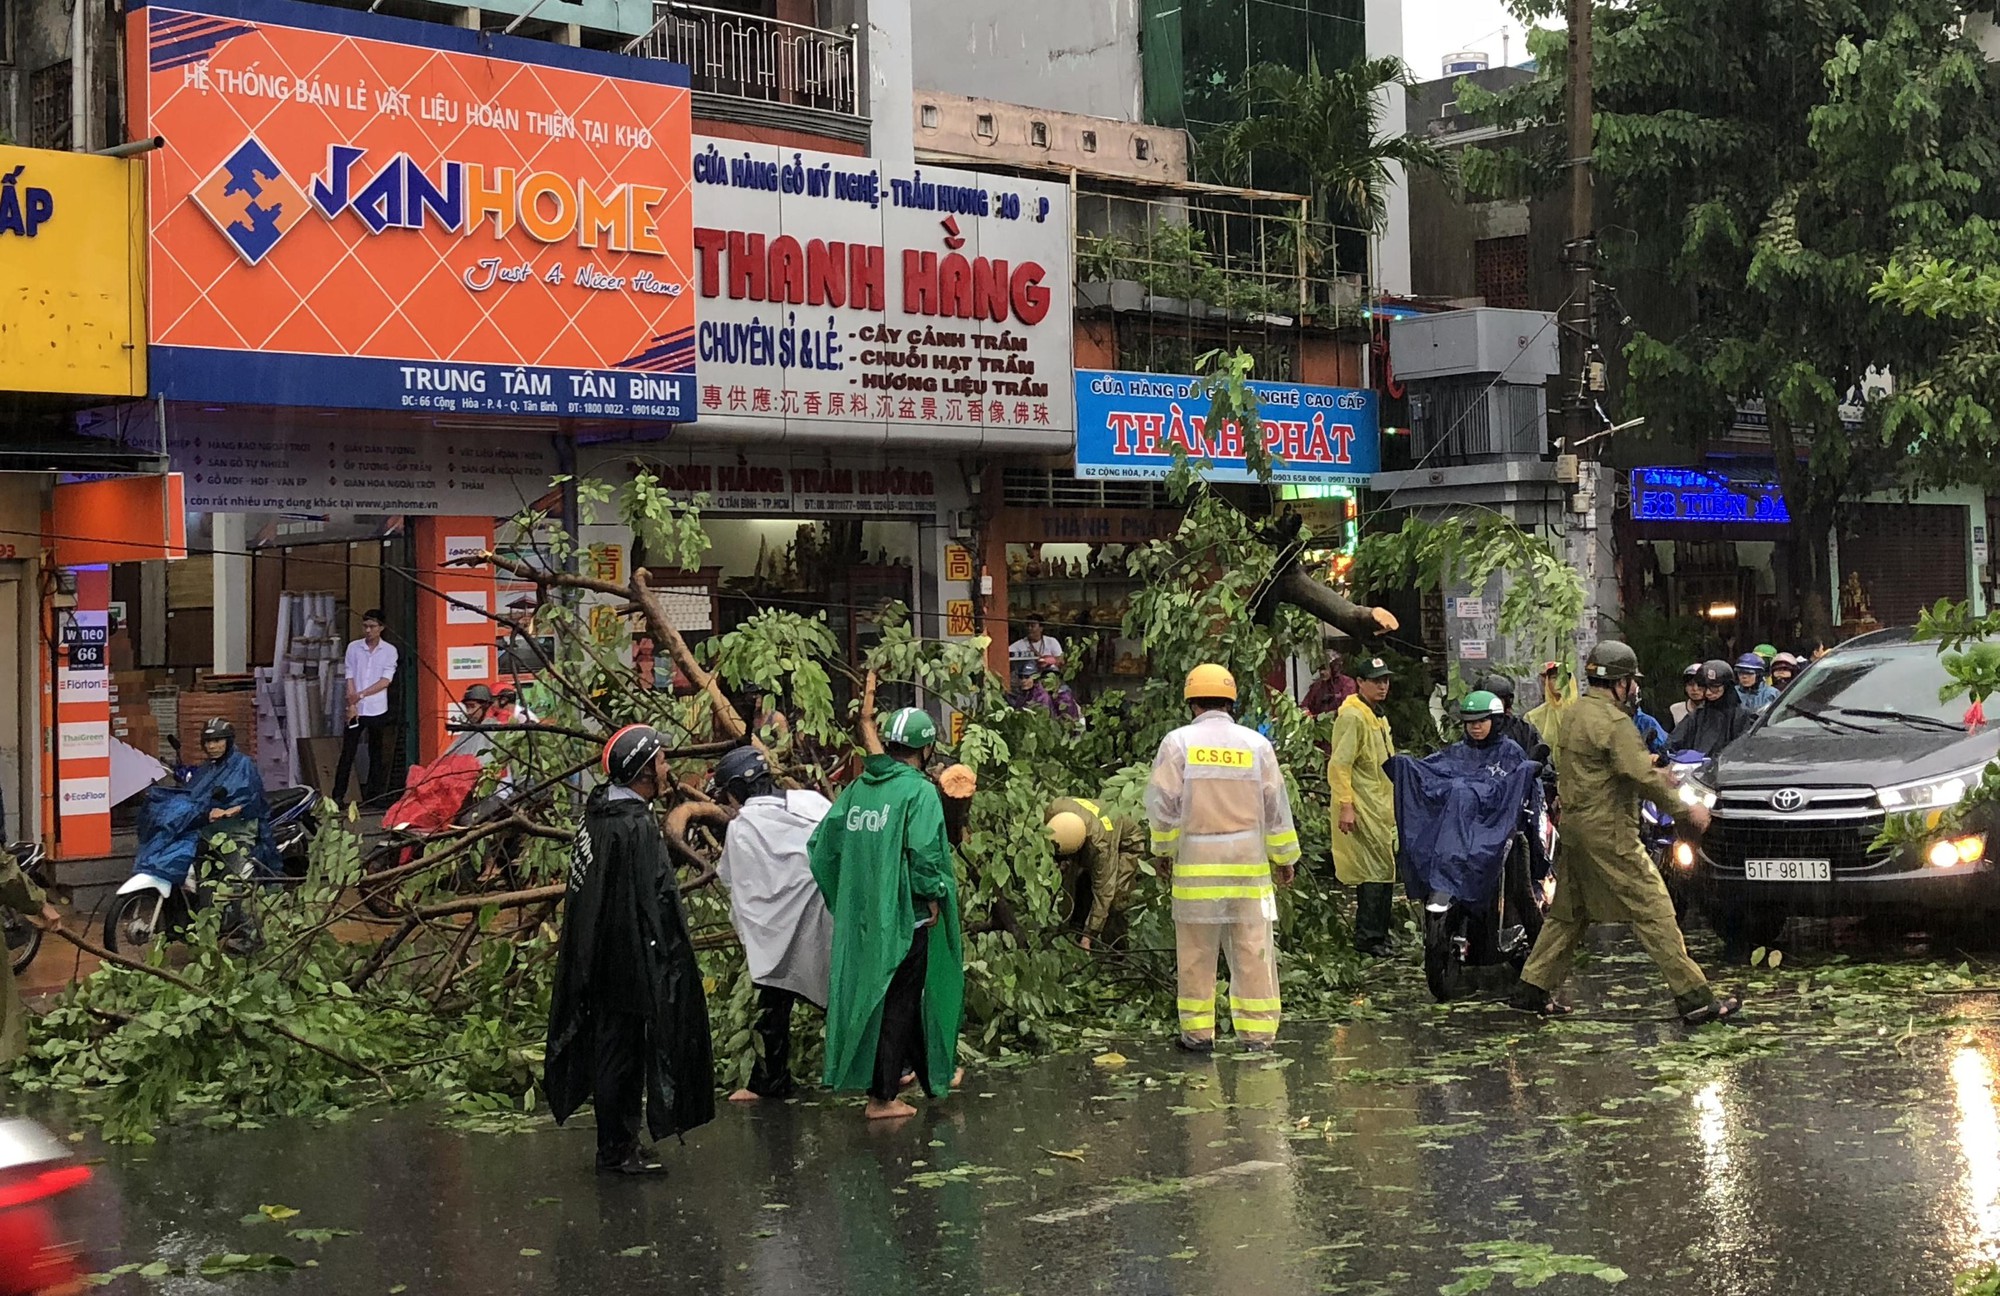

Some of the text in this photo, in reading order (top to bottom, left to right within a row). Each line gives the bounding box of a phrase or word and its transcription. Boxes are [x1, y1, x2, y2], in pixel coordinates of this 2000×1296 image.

[184, 60, 209, 96] HỆ
[215, 61, 288, 100] THỐNG
[295, 74, 339, 107] BÁN
[347, 79, 367, 110] LẺ
[375, 86, 410, 120] VẬT
[421, 92, 458, 126] LIỆU
[465, 100, 519, 131] HOÀN
[526, 109, 575, 142] THIỆN
[582, 120, 608, 148] TẠI
[693, 143, 728, 185] CỬA
[731, 152, 778, 191] HÀNG
[781, 153, 805, 195] GỖ
[834, 170, 880, 210] NGHỆ
[308, 143, 668, 255] JANHOME
[463, 257, 681, 295] Just A Nicer Home
[694, 215, 1051, 326] THANH HẰNG
[699, 316, 775, 366] CHUYÊN
[800, 328, 813, 369] &
[815, 315, 844, 370] LẺ:
[859, 323, 902, 344] CÂY
[907, 325, 966, 348] CẢNH
[860, 345, 928, 369] CHUỖI
[932, 354, 973, 374] HẠT
[400, 366, 680, 401] TRUNG TÂM TÂN BÌNH
[862, 372, 938, 393] HƯƠNG
[942, 375, 988, 398] LIỆU
[1091, 375, 1126, 396] CỬA
[1129, 379, 1174, 399] HÀNG
[1305, 393, 1334, 408] CAO
[1337, 392, 1366, 410] CẤP
[401, 395, 680, 417] ĐC: 66 Cộng Hòa P. 4 Q. Tân Bình ĐT: 1800 0022 0901 642 233
[1107, 402, 1356, 463] THÀNH PHÁT
[1085, 468, 1096, 476] 62
[1098, 467, 1120, 477] CỘNG
[1122, 467, 1141, 477] HÒA,
[1273, 473, 1292, 482] 0903
[1643, 492, 1676, 516] 58
[78, 647, 97, 661] 66
[1196, 749, 1244, 765] C.S.G.T
[72, 791, 106, 801] EcoFloor
[847, 803, 890, 832] Grab
